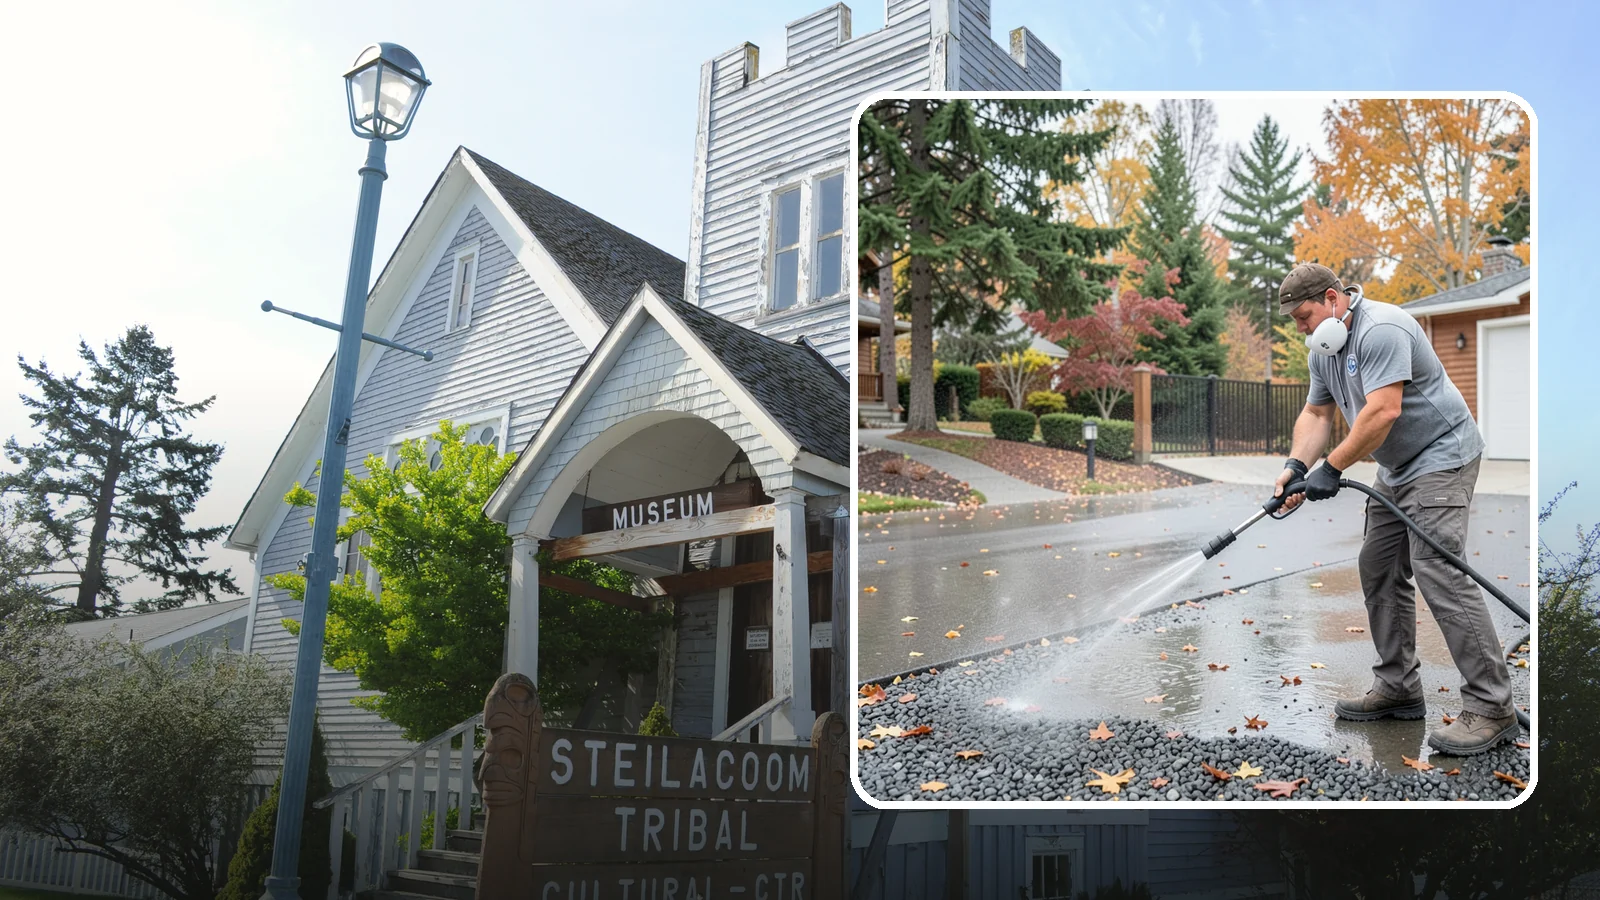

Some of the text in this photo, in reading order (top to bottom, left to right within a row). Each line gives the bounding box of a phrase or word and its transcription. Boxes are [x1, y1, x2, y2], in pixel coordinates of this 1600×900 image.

[613, 492, 713, 530] MUSEUM
[551, 738, 809, 792] STEILACOOM
[615, 807, 758, 851] TRIBAL
